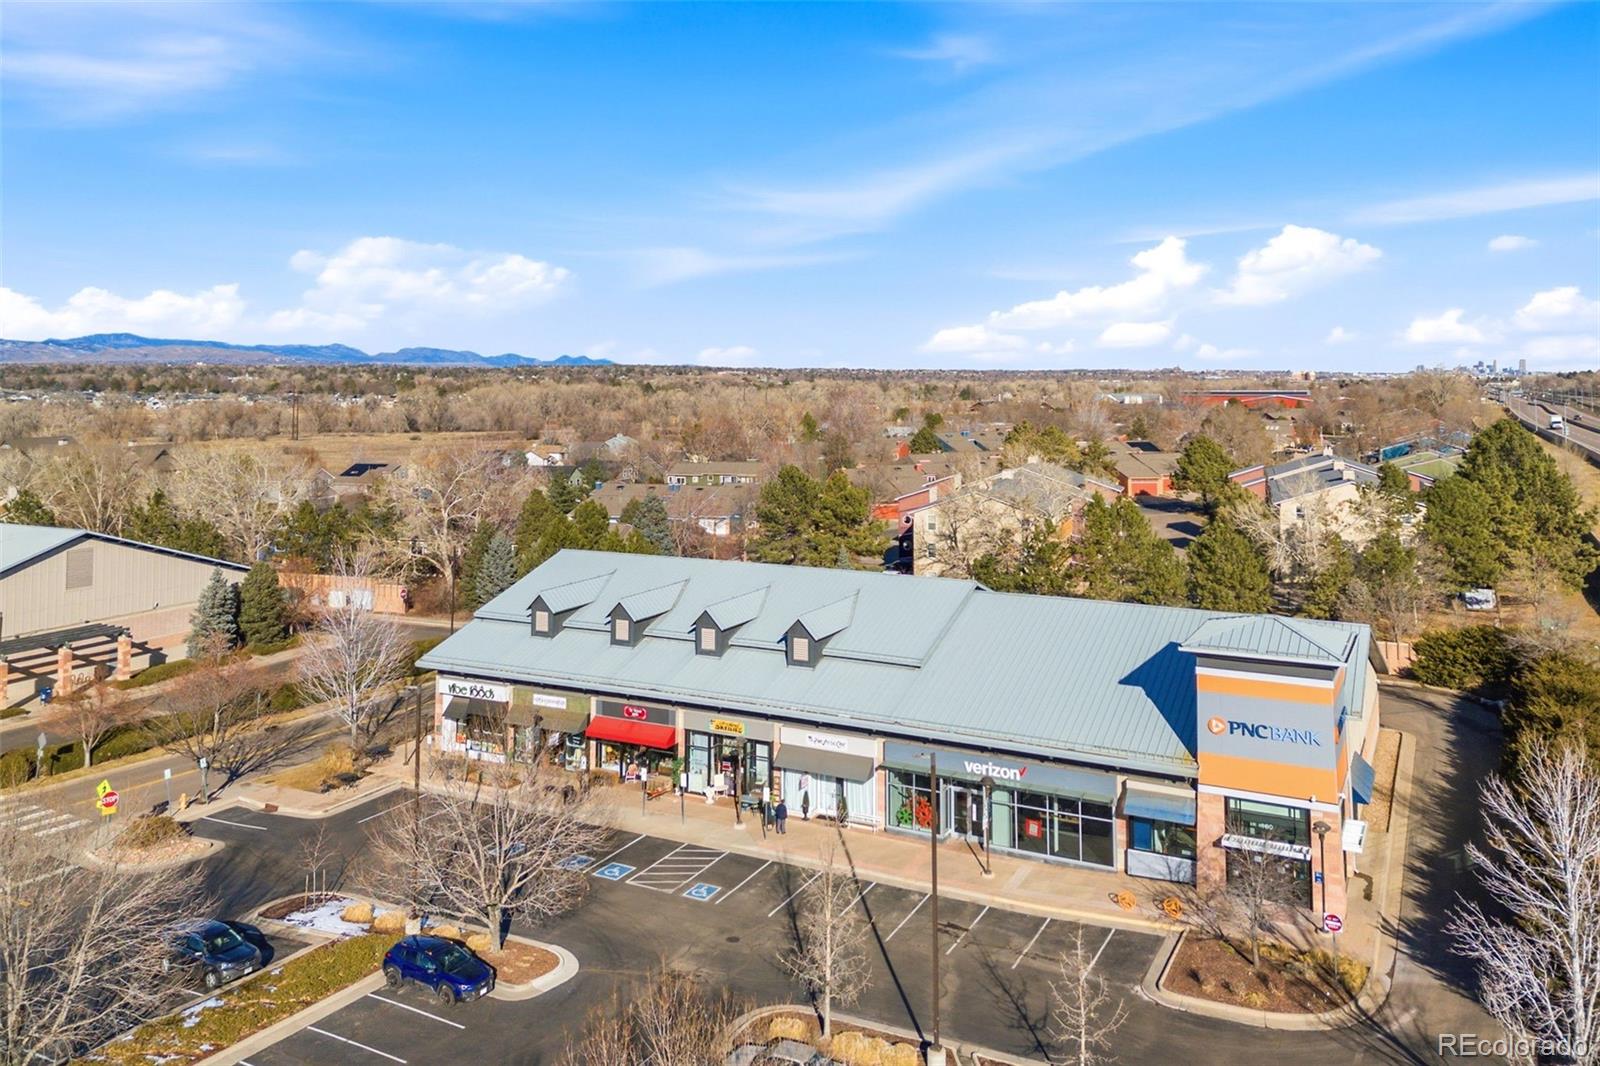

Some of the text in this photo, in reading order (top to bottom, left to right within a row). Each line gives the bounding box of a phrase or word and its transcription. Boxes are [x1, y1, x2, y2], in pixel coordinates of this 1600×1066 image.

[1227, 720, 1321, 747] PNC BANK
[964, 760, 1021, 781] verizon
[102, 795, 119, 804] STOP
